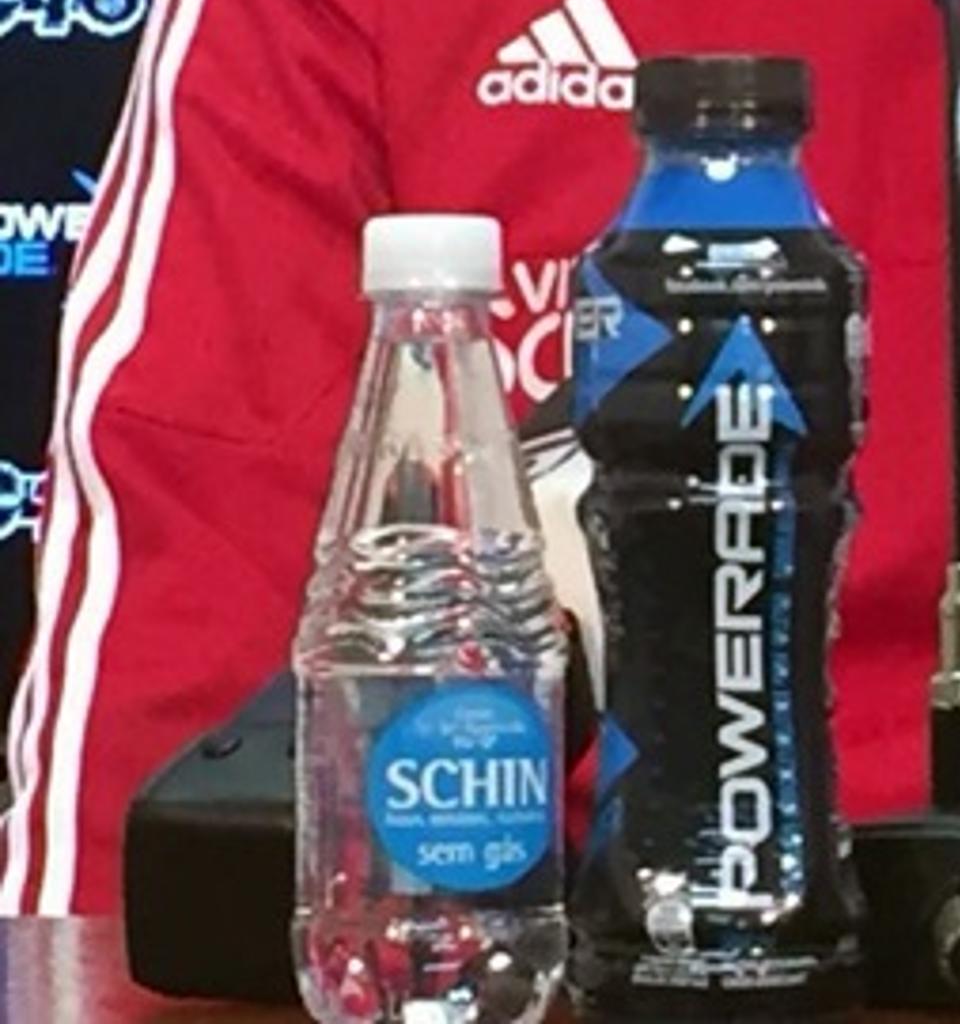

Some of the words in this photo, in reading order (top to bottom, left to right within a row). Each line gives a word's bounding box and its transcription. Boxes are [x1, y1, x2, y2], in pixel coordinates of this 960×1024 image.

[476, 58, 636, 112] adida
[574, 293, 626, 341] ER
[711, 382, 775, 909] POWERADE
[385, 757, 549, 810] SCHIN
[416, 841, 475, 866] sem
